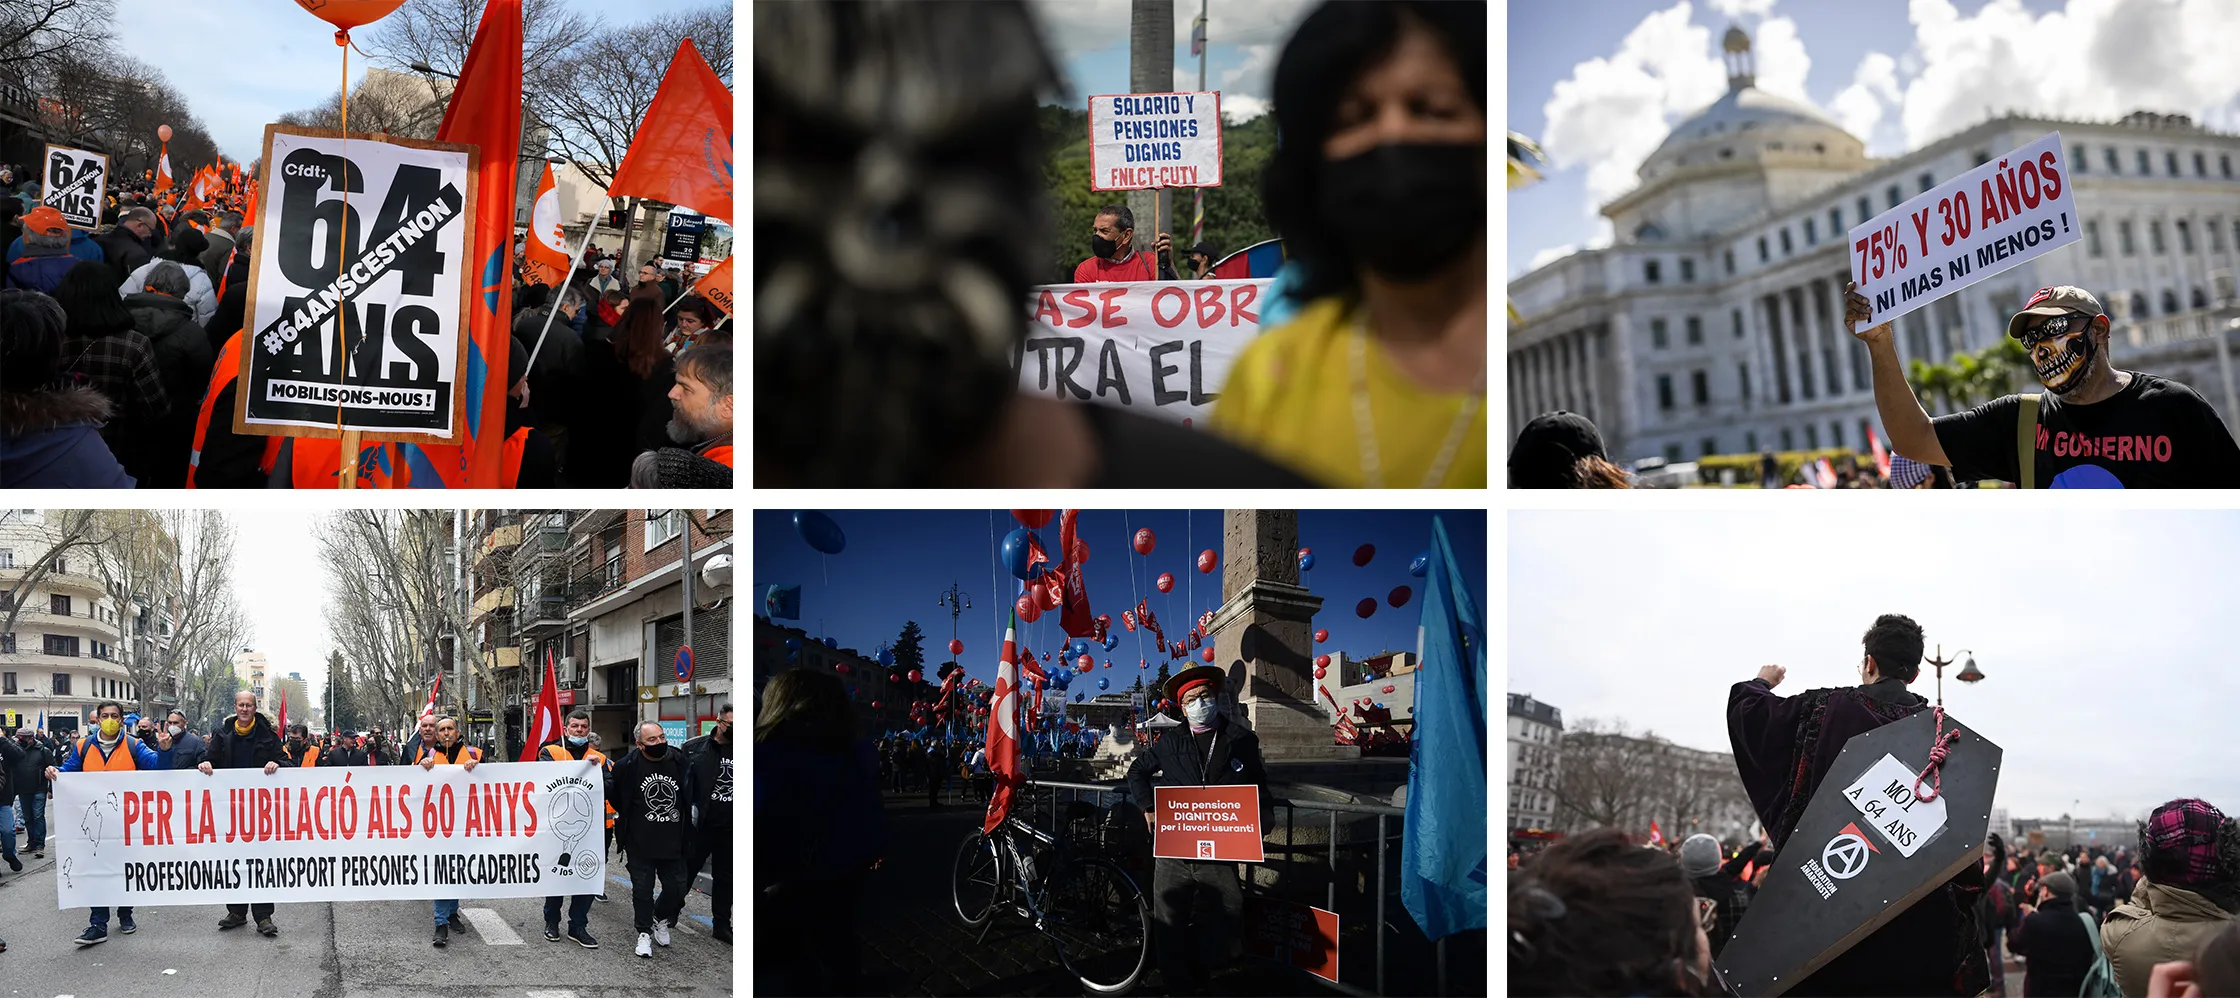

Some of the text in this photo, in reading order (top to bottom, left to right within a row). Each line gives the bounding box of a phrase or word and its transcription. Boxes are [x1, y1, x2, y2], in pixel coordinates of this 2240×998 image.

[1113, 95, 1194, 115] SALARIO Y
[1113, 119, 1198, 140] PENSIONES
[1125, 142, 1181, 162] DIGNAS
[50, 152, 98, 194] 64
[277, 148, 446, 298] 64
[1855, 150, 2062, 286] 75% Y 30 AÑOS
[262, 196, 452, 356] #64ANSCESTNON
[1876, 287, 1896, 313] NI
[1901, 266, 1943, 302] MAS
[1948, 253, 1971, 281] NI
[1976, 219, 2056, 269] MENOS
[708, 287, 733, 310] COM
[1028, 284, 1260, 329] ASE OBR
[271, 383, 423, 407] MOBILISONS-NOUS
[545, 775, 594, 793] Jubilación
[640, 772, 680, 792] Jubilación
[1882, 779, 1919, 814] MOI
[123, 771, 538, 846] PER LA JUBILACIÓ ALS 60 ANYS
[656, 814, 670, 822] los
[1168, 800, 1241, 811] Una pensione
[1174, 812, 1239, 822] DIGNITOSA
[1849, 787, 1918, 847] A 64 ANS
[1160, 823, 1255, 833] per i lavori usuranti
[124, 852, 541, 892] PROFESIONALS TRANSPORT PERSONES I MERCADERIES
[551, 866, 574, 876] a los
[1800, 864, 1832, 900] ANARCHISTE
[1806, 859, 1838, 894] FÉDÉRATION
